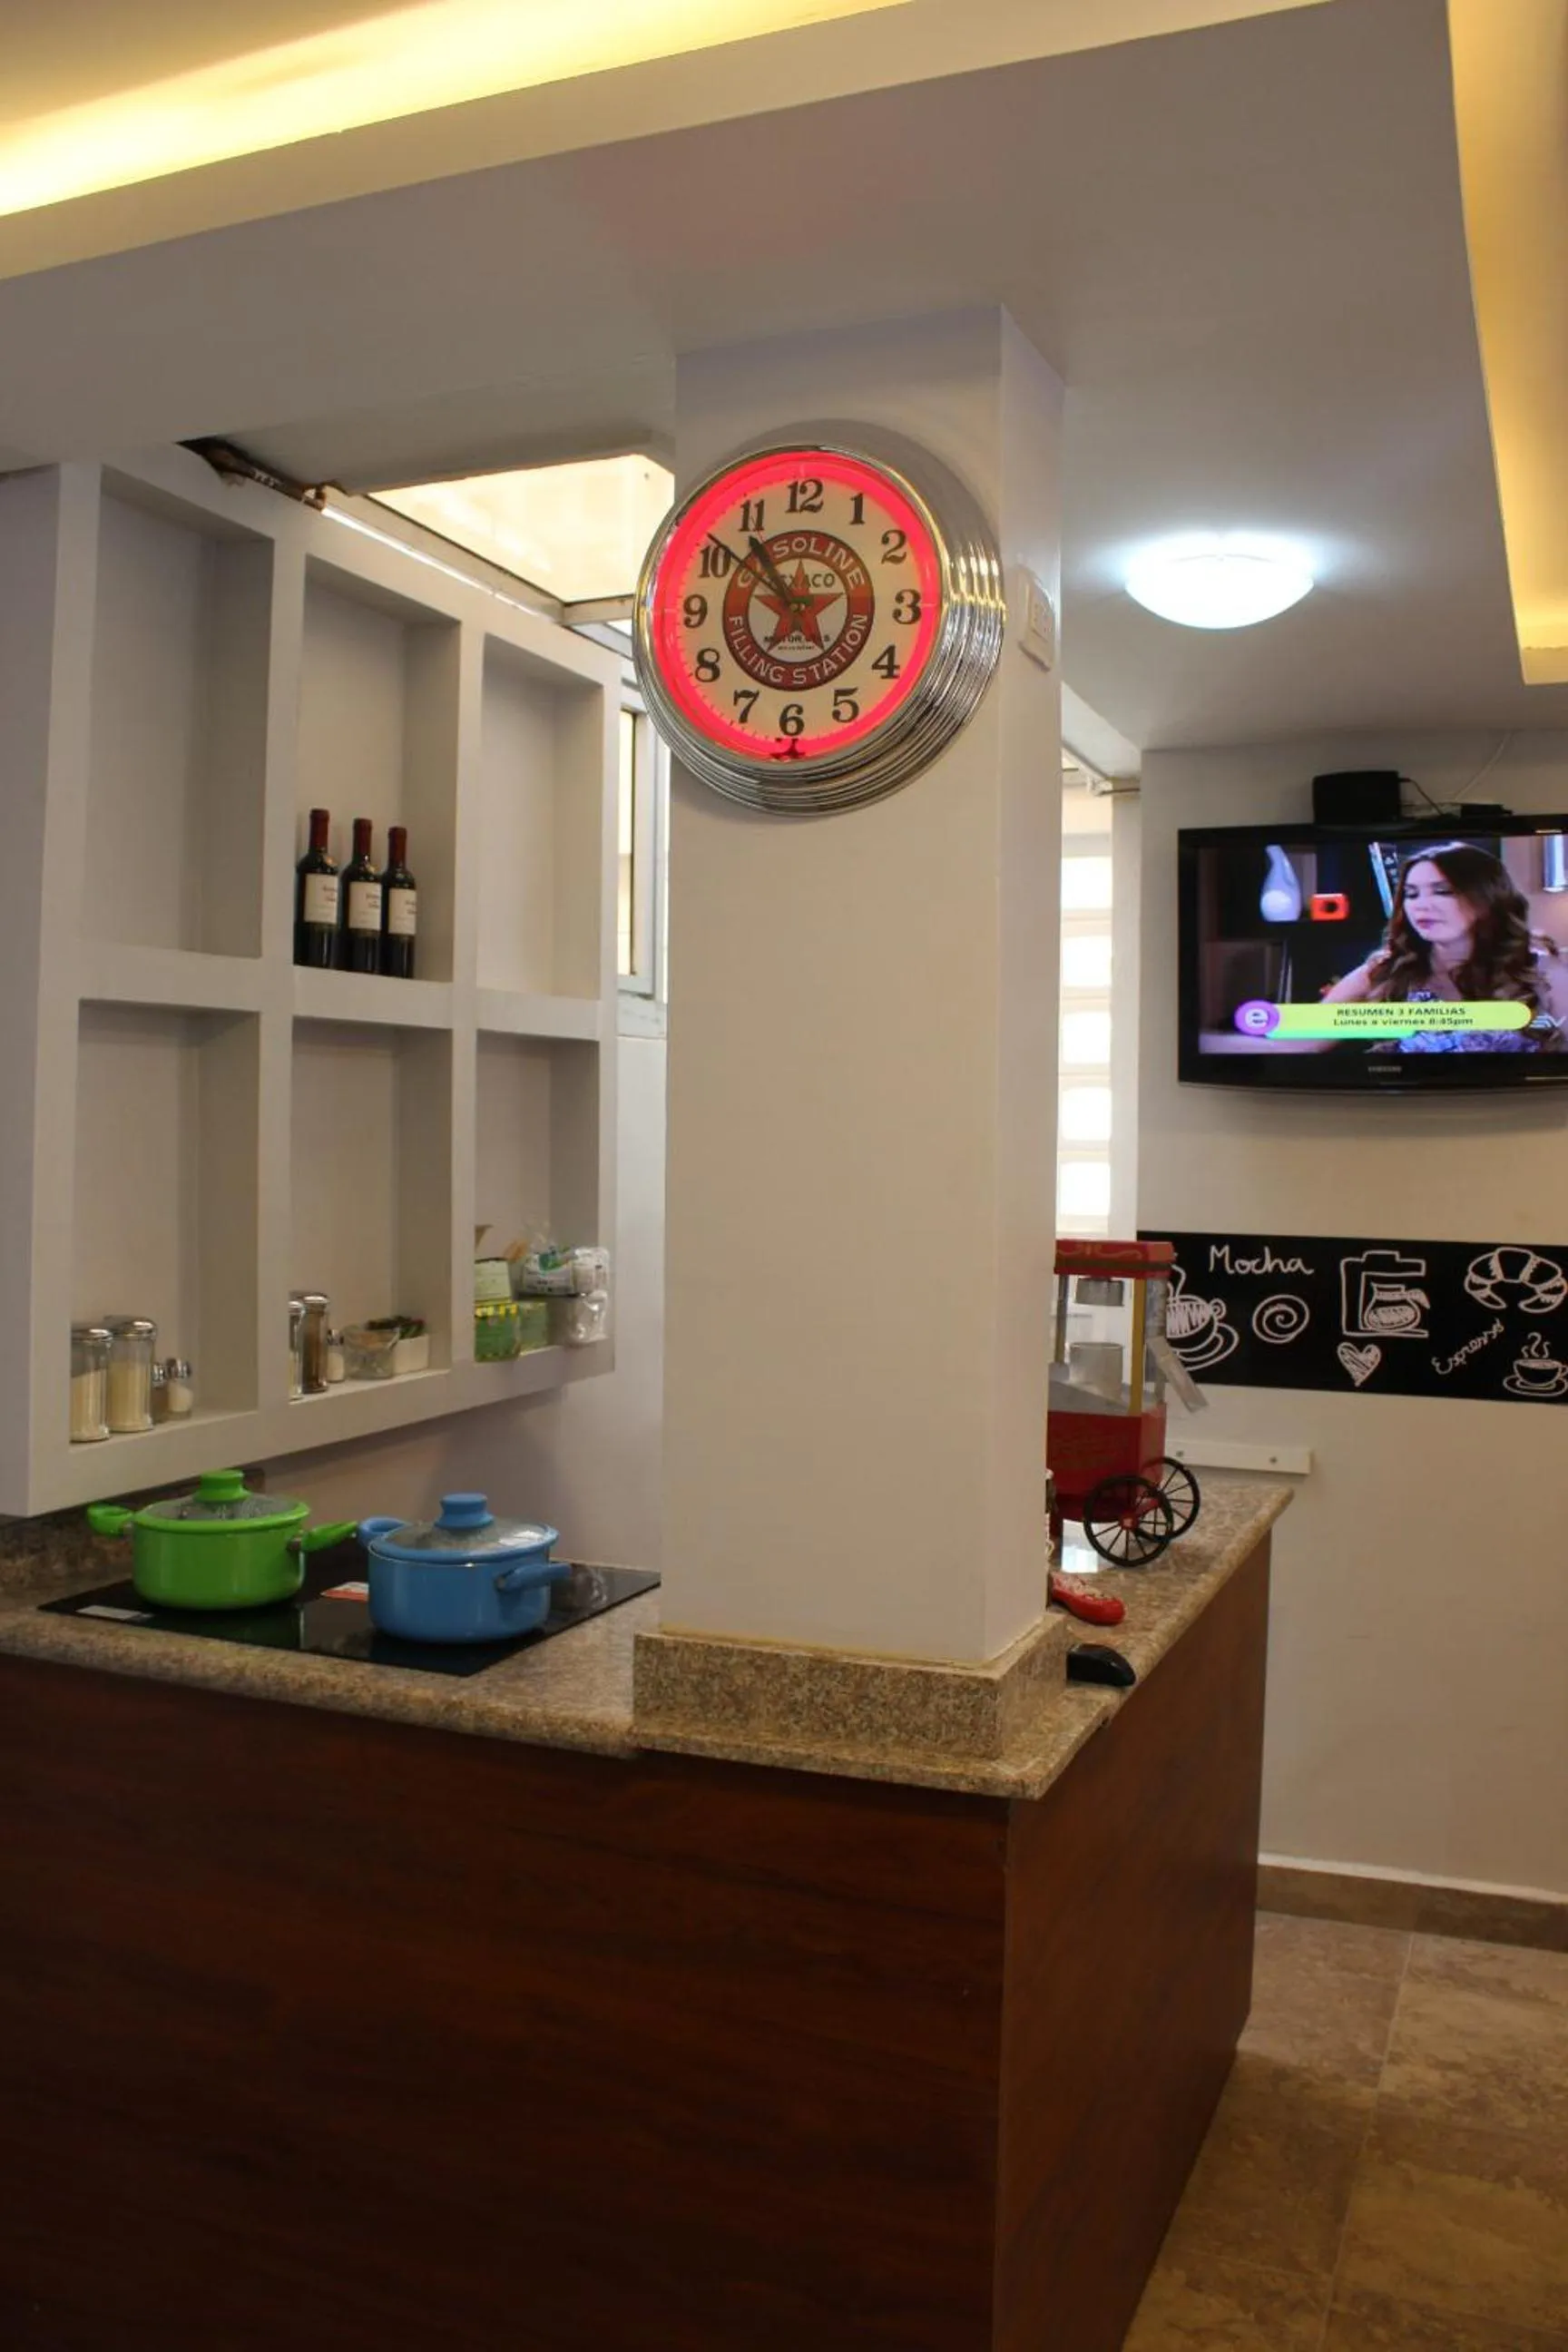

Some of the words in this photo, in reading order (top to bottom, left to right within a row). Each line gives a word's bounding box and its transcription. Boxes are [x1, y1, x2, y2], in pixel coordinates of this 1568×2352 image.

[785, 478, 824, 514] 12
[848, 493, 866, 525] 1
[739, 498, 765, 533] 11
[698, 544, 731, 579] 10
[880, 529, 906, 564] 2
[683, 593, 709, 629] 9
[892, 589, 923, 625] 3
[694, 648, 722, 683] 8
[729, 615, 786, 683] FILLING
[792, 613, 867, 685] STATION
[871, 644, 901, 680] 4
[732, 689, 760, 725] 7
[779, 703, 805, 737] 6
[832, 688, 861, 724] 5
[1334, 1018, 1367, 1026] Lunes
[1337, 1007, 1395, 1016] RESUMEN
[1408, 1006, 1466, 1015] FAMILIAS
[1209, 1243, 1315, 1276] Mocha
